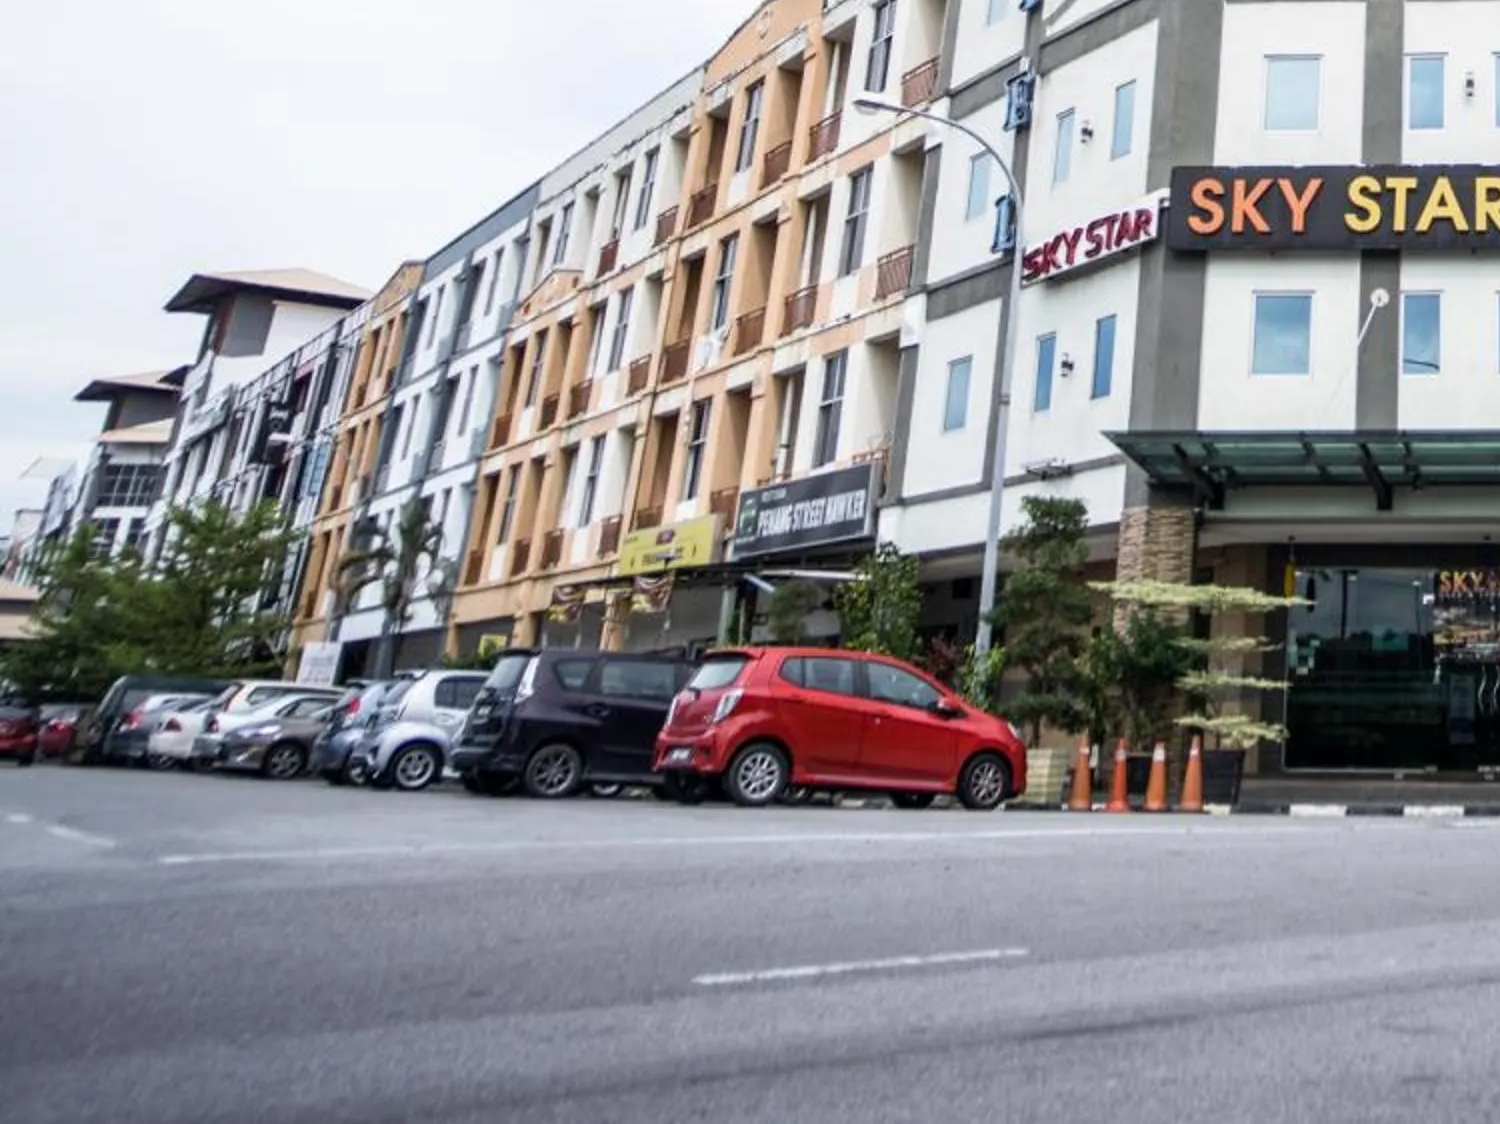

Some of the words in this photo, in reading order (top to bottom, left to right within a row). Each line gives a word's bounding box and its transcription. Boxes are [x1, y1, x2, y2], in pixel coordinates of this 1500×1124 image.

[1187, 177, 1323, 235] SKY
[1022, 227, 1084, 278] SKY
[1084, 208, 1153, 259] STAR
